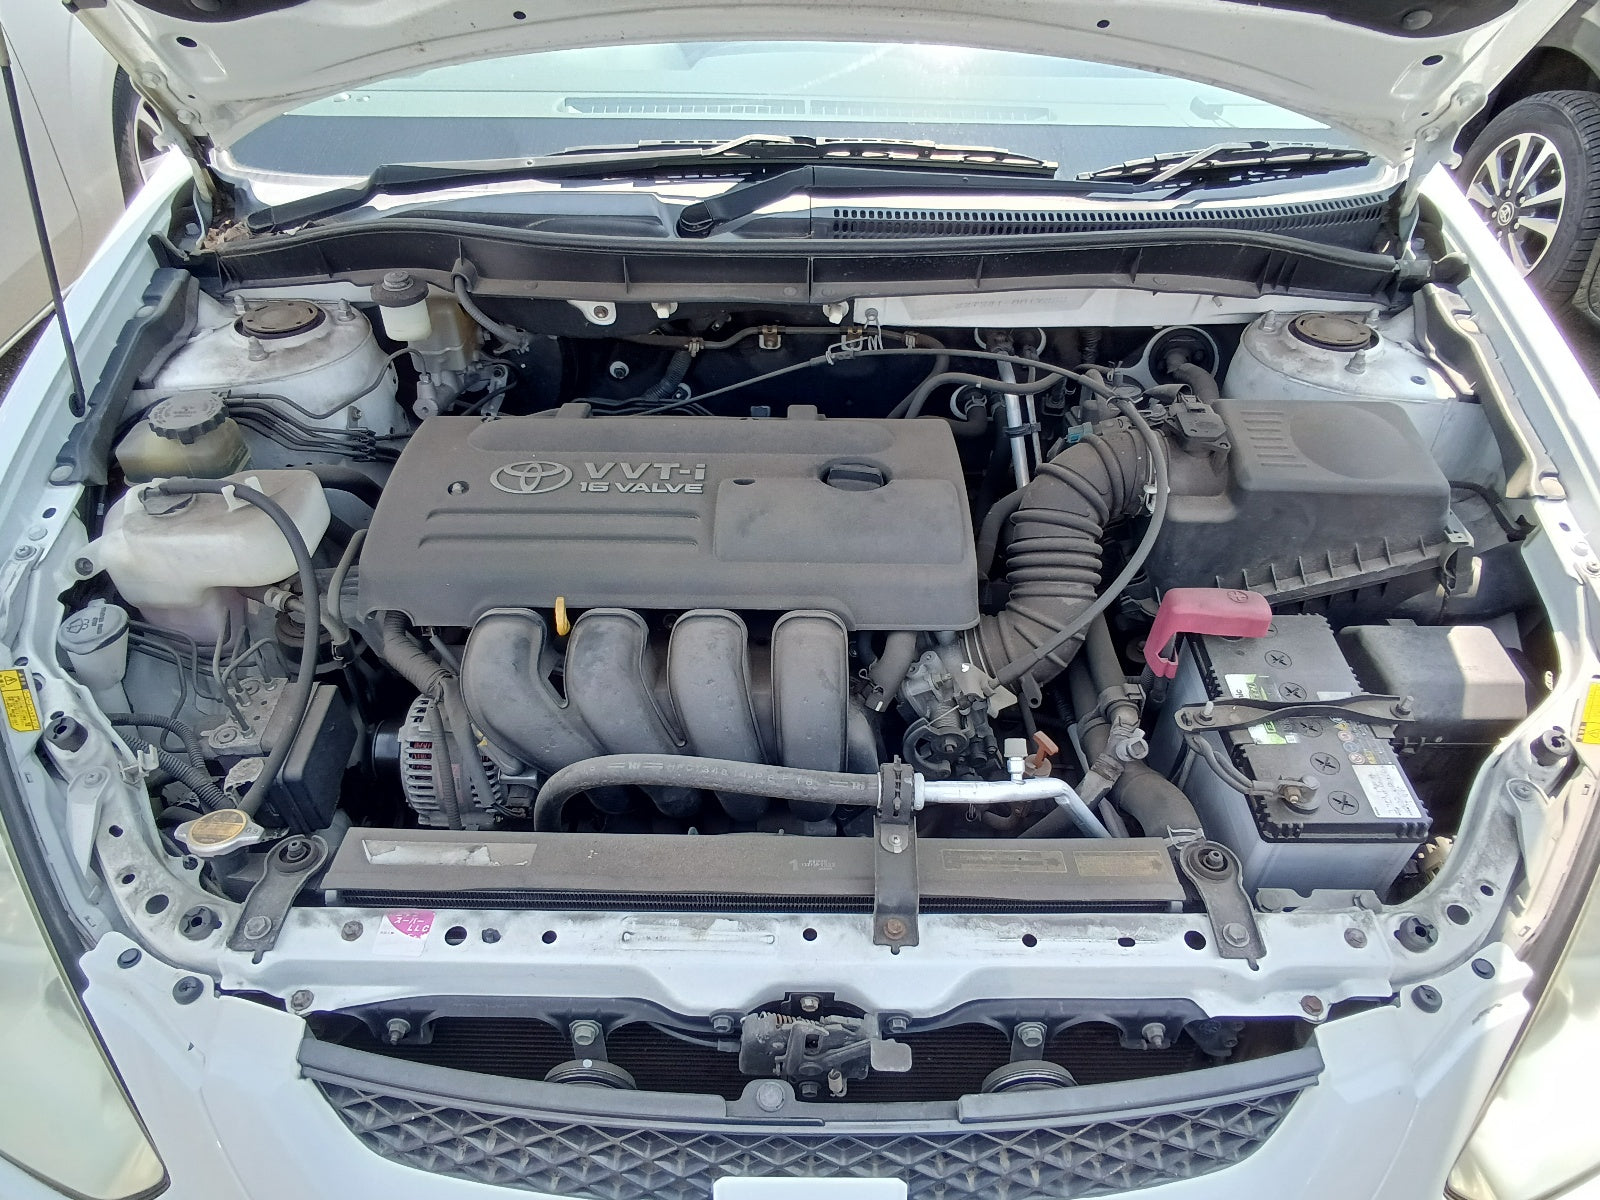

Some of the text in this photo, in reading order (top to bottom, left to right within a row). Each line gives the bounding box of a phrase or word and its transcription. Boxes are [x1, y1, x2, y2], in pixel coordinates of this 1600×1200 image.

[584, 462, 707, 481] VVT-i
[580, 481, 704, 494] 16 VALVE
[406, 924, 430, 933] LLC
